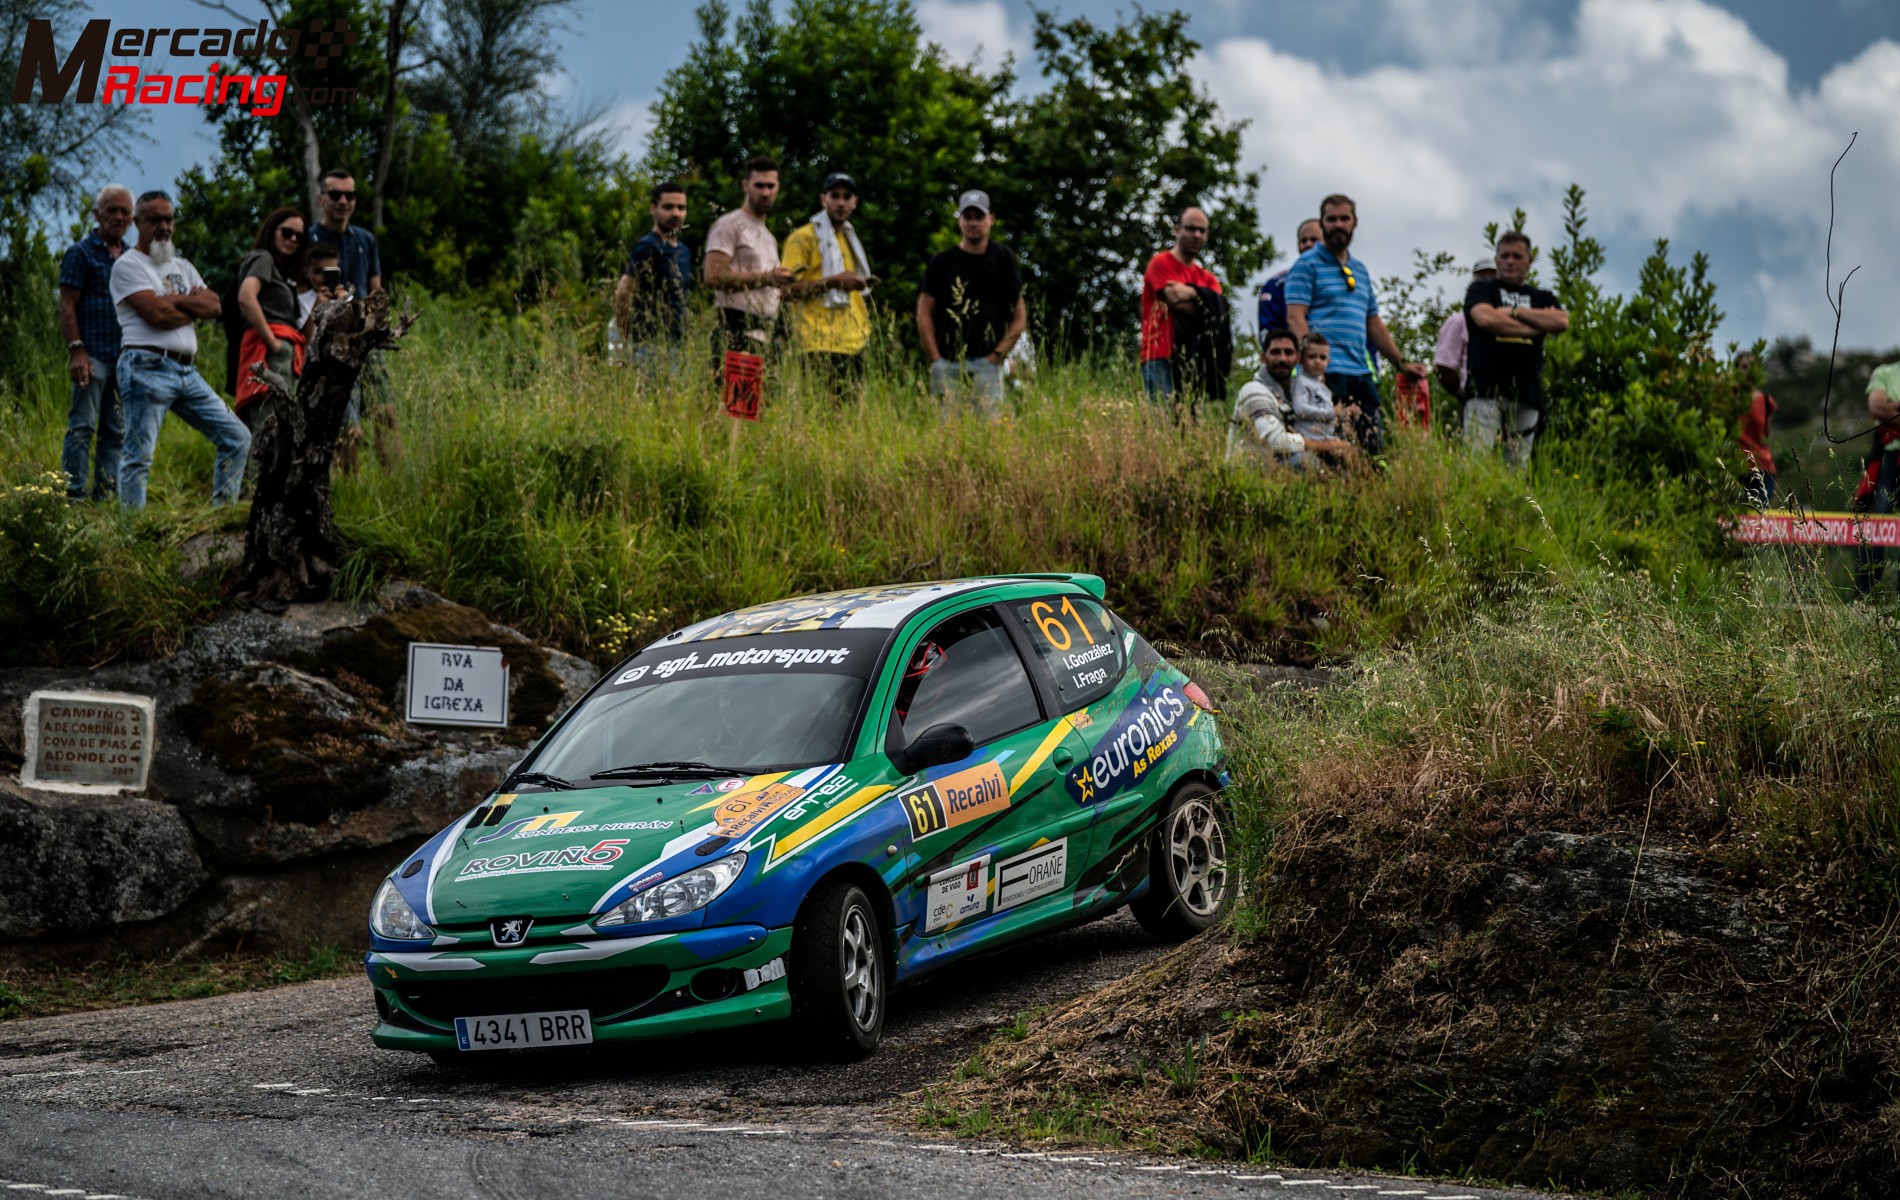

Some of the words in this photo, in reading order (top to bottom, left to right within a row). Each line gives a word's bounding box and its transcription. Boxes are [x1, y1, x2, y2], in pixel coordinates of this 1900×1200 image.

[1031, 596, 1094, 650] 61
[652, 647, 850, 678] sgh_motorsport
[1062, 642, 1114, 670] I.González
[443, 677, 464, 692] DA
[1072, 667, 1107, 689] I.Fraga
[49, 705, 125, 720] CAMPIÑO
[424, 695, 483, 712] IGREXA
[44, 722, 52, 731] A
[54, 722, 69, 733] DE
[1092, 687, 1185, 788] euronics
[43, 737, 75, 748] COVA
[80, 738, 95, 749] DE
[1133, 759, 1147, 779] As
[1147, 729, 1178, 764] Rexas
[726, 799, 752, 812] 61
[909, 790, 939, 834] 61
[946, 773, 1002, 814] Recalvi
[731, 804, 767, 831] Recalvi
[512, 824, 599, 840] SONDEOS
[941, 885, 949, 894] DE
[950, 880, 961, 891] VIGO
[474, 1017, 530, 1045] 4341
[539, 1014, 587, 1042] BRR
